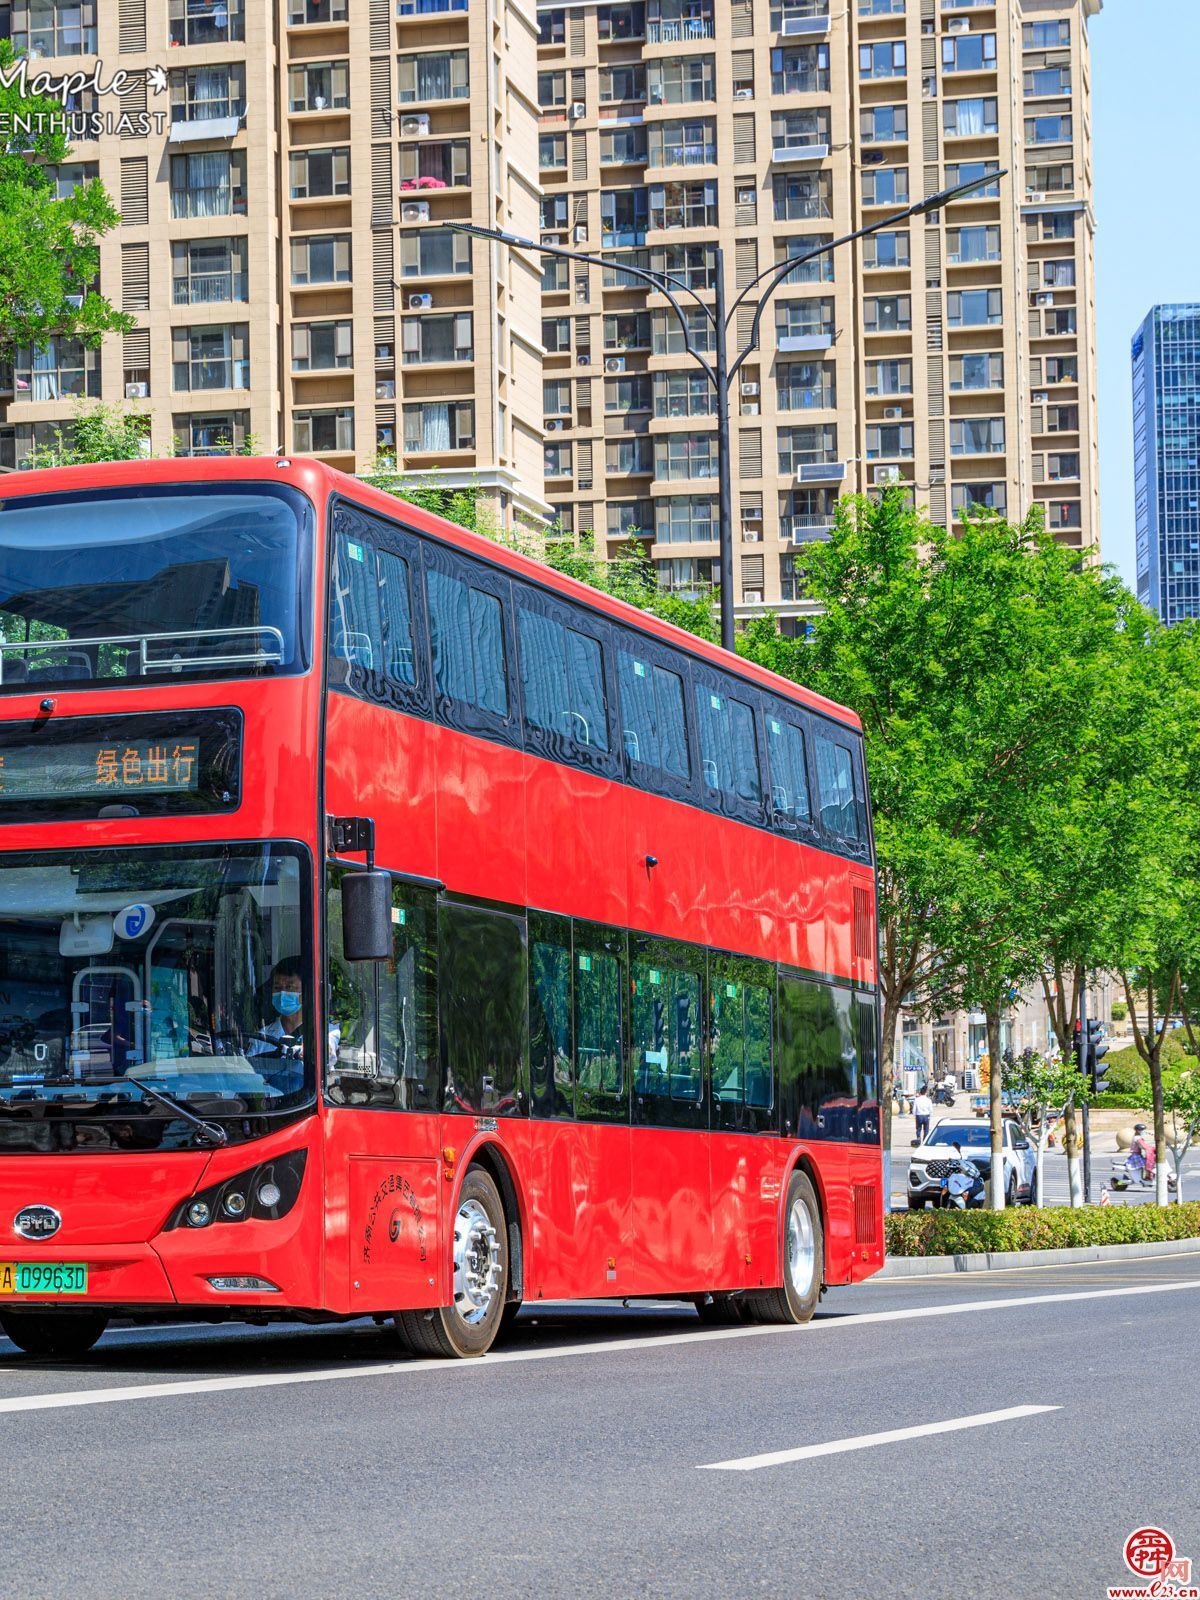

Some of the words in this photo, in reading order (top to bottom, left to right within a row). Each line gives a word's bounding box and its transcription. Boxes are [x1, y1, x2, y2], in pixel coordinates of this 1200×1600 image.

[95, 745, 196, 785] 绿色出行
[19, 1215, 56, 1230] BYD
